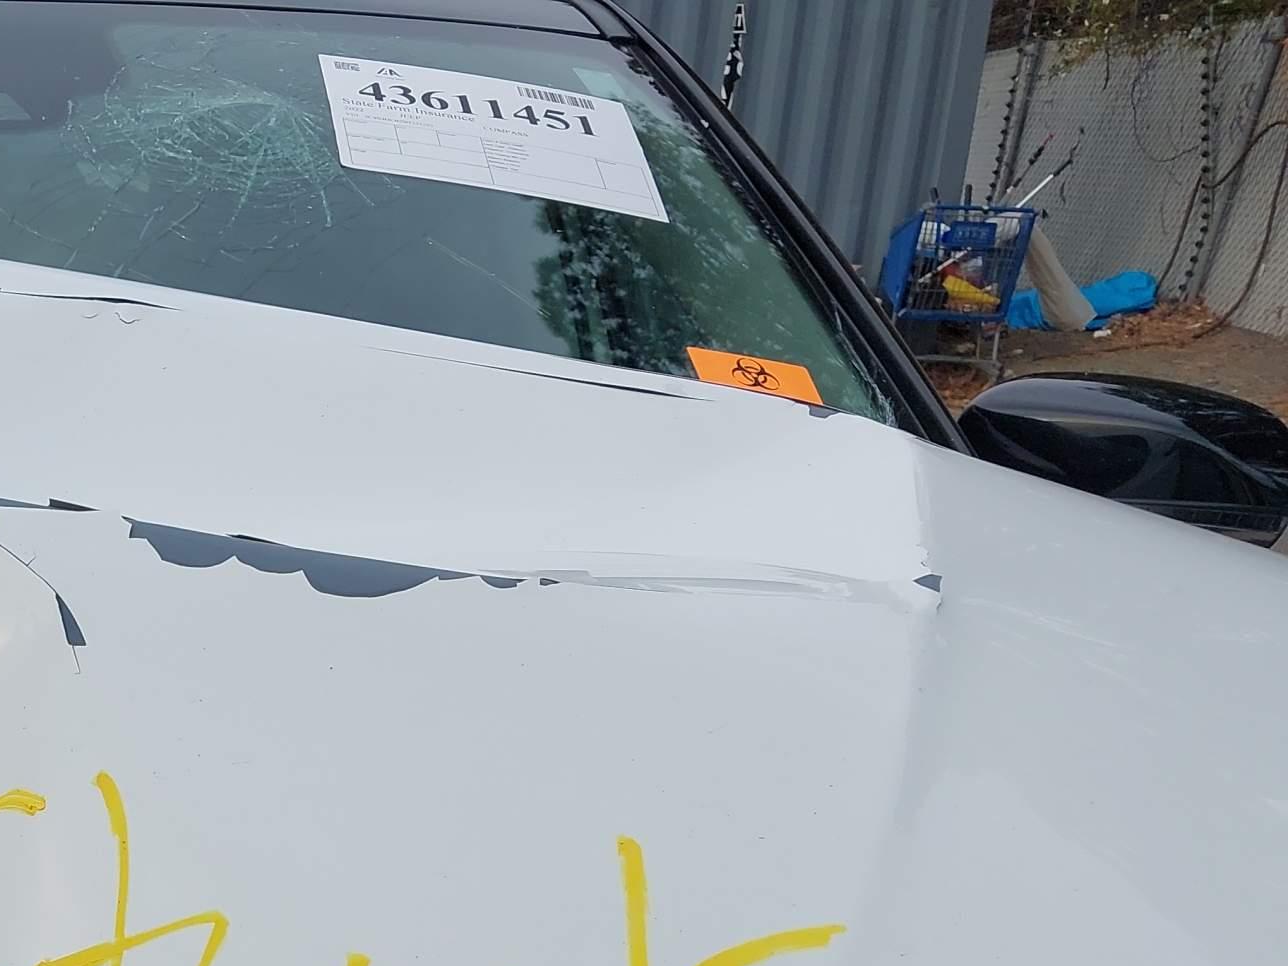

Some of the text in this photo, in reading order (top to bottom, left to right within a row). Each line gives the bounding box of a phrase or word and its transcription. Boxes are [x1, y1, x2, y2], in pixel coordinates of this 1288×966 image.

[342, 97, 374, 108] State
[377, 102, 411, 113] Farm
[415, 107, 476, 122] Insurance
[358, 81, 600, 137] 43611451
